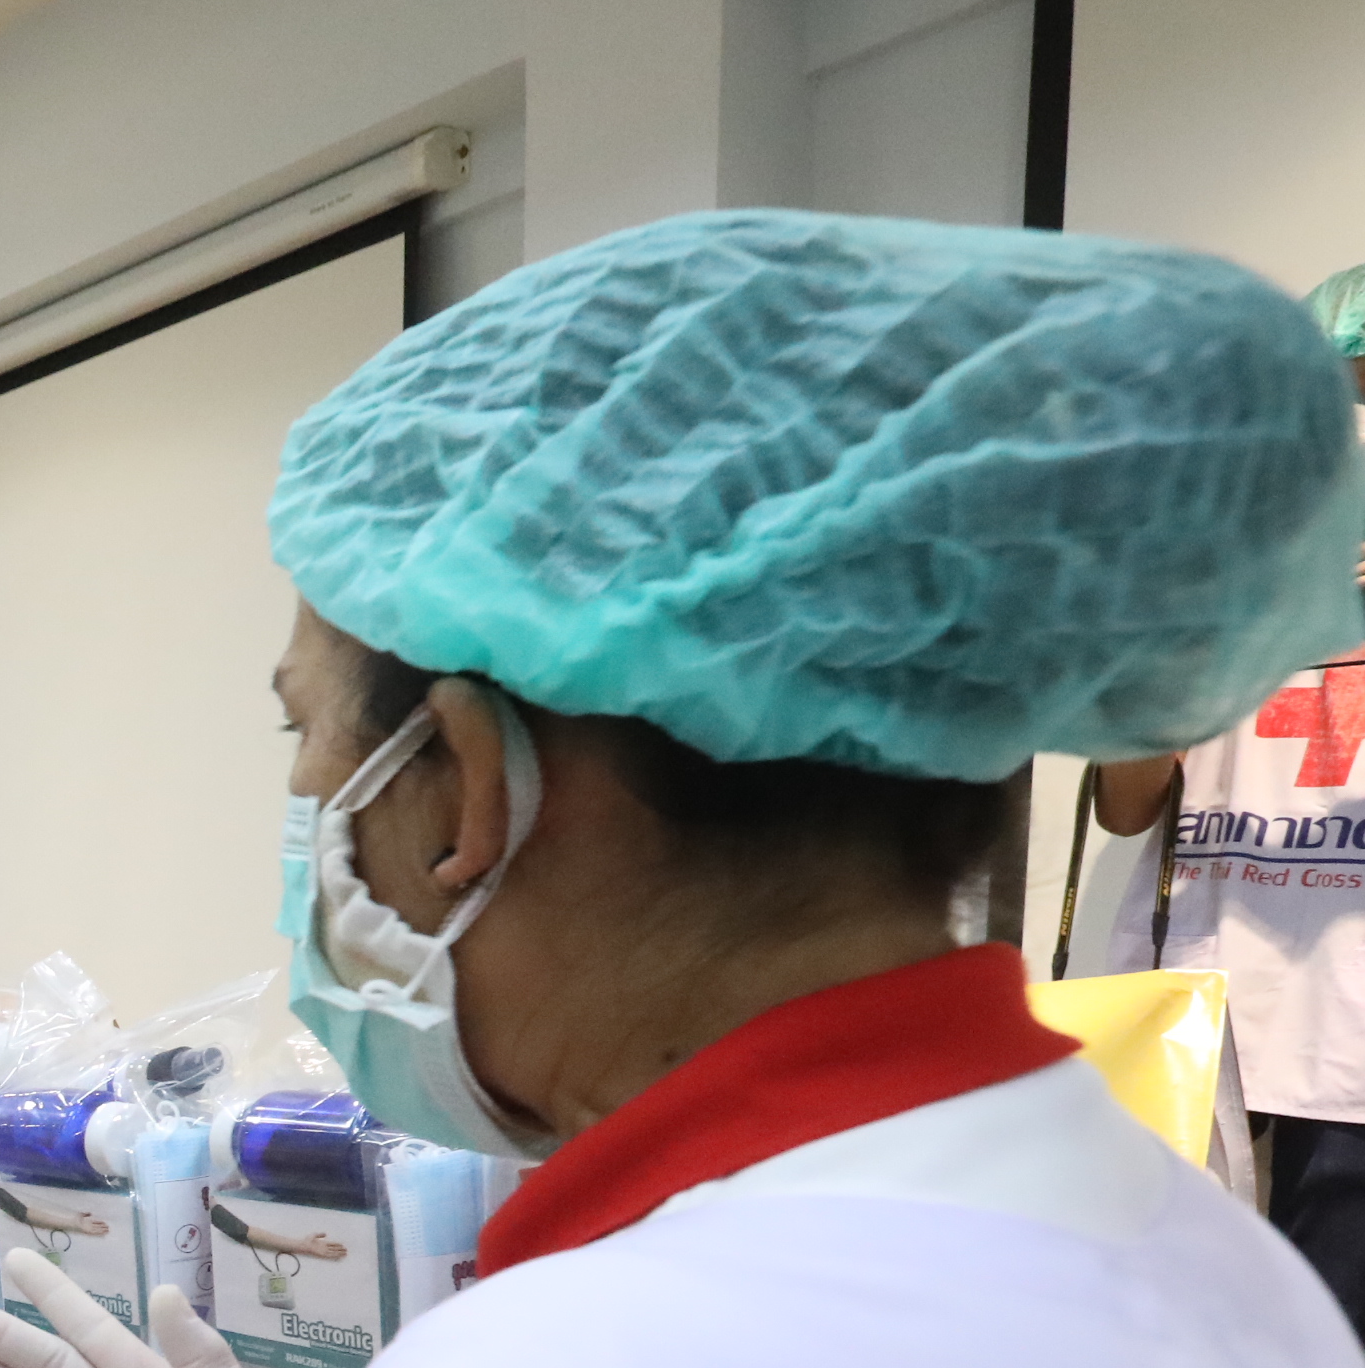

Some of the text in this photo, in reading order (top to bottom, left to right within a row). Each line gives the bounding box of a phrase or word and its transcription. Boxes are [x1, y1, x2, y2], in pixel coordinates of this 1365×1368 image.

[1242, 864, 1290, 887] Red
[1301, 868, 1362, 889] Cross
[281, 1312, 374, 1352] Electronic
